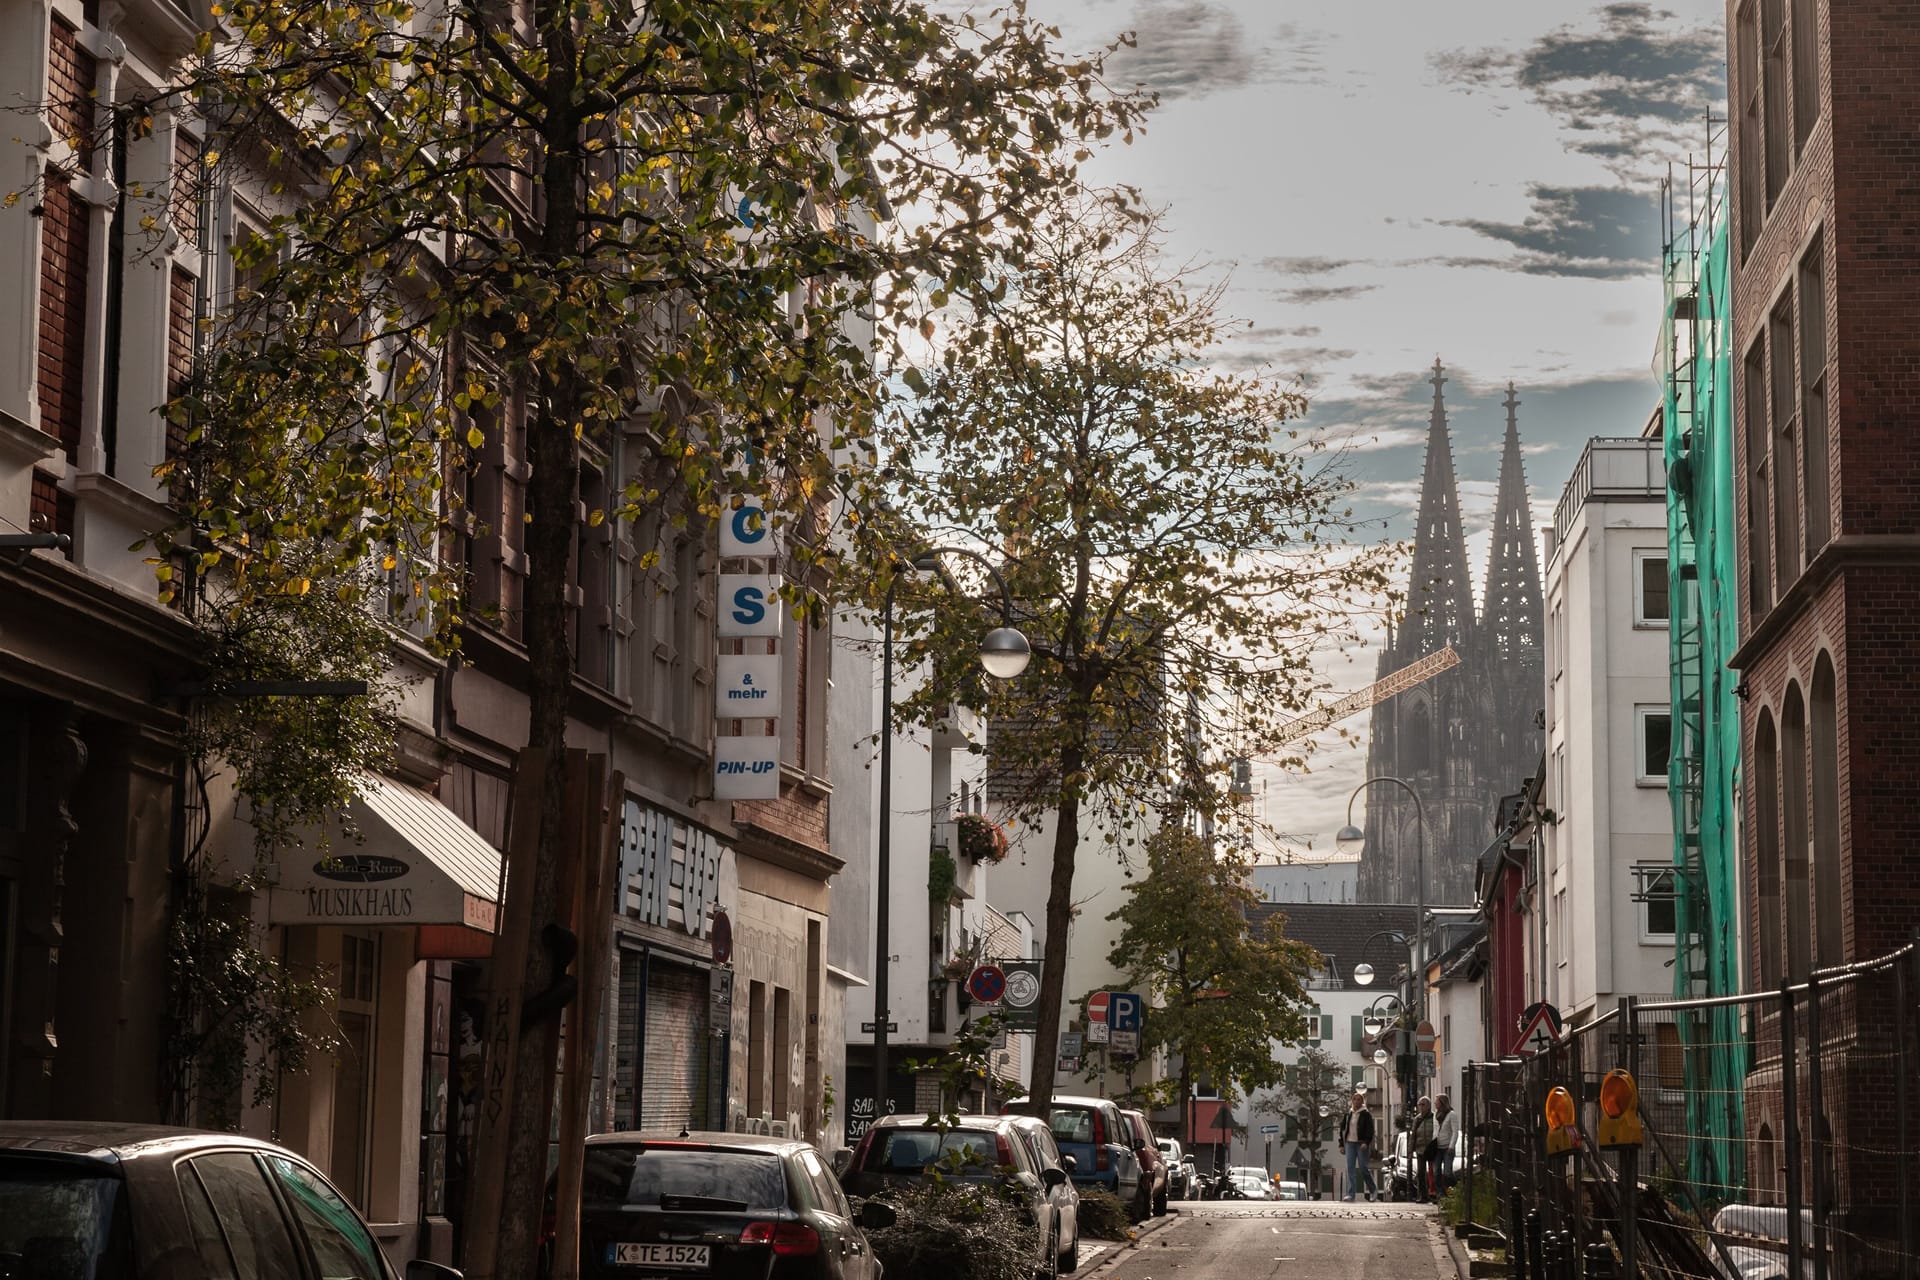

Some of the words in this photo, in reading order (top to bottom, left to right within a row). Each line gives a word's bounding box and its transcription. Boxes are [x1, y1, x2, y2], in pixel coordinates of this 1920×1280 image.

[742, 673, 753, 685] &
[728, 688, 767, 699] mehr
[717, 761, 774, 774] PIN-UP
[306, 888, 413, 917] MUSIKHAUS
[1115, 998, 1134, 1028] P
[616, 1244, 628, 1262] K
[640, 1245, 661, 1263] TE
[664, 1246, 707, 1265] 1524
